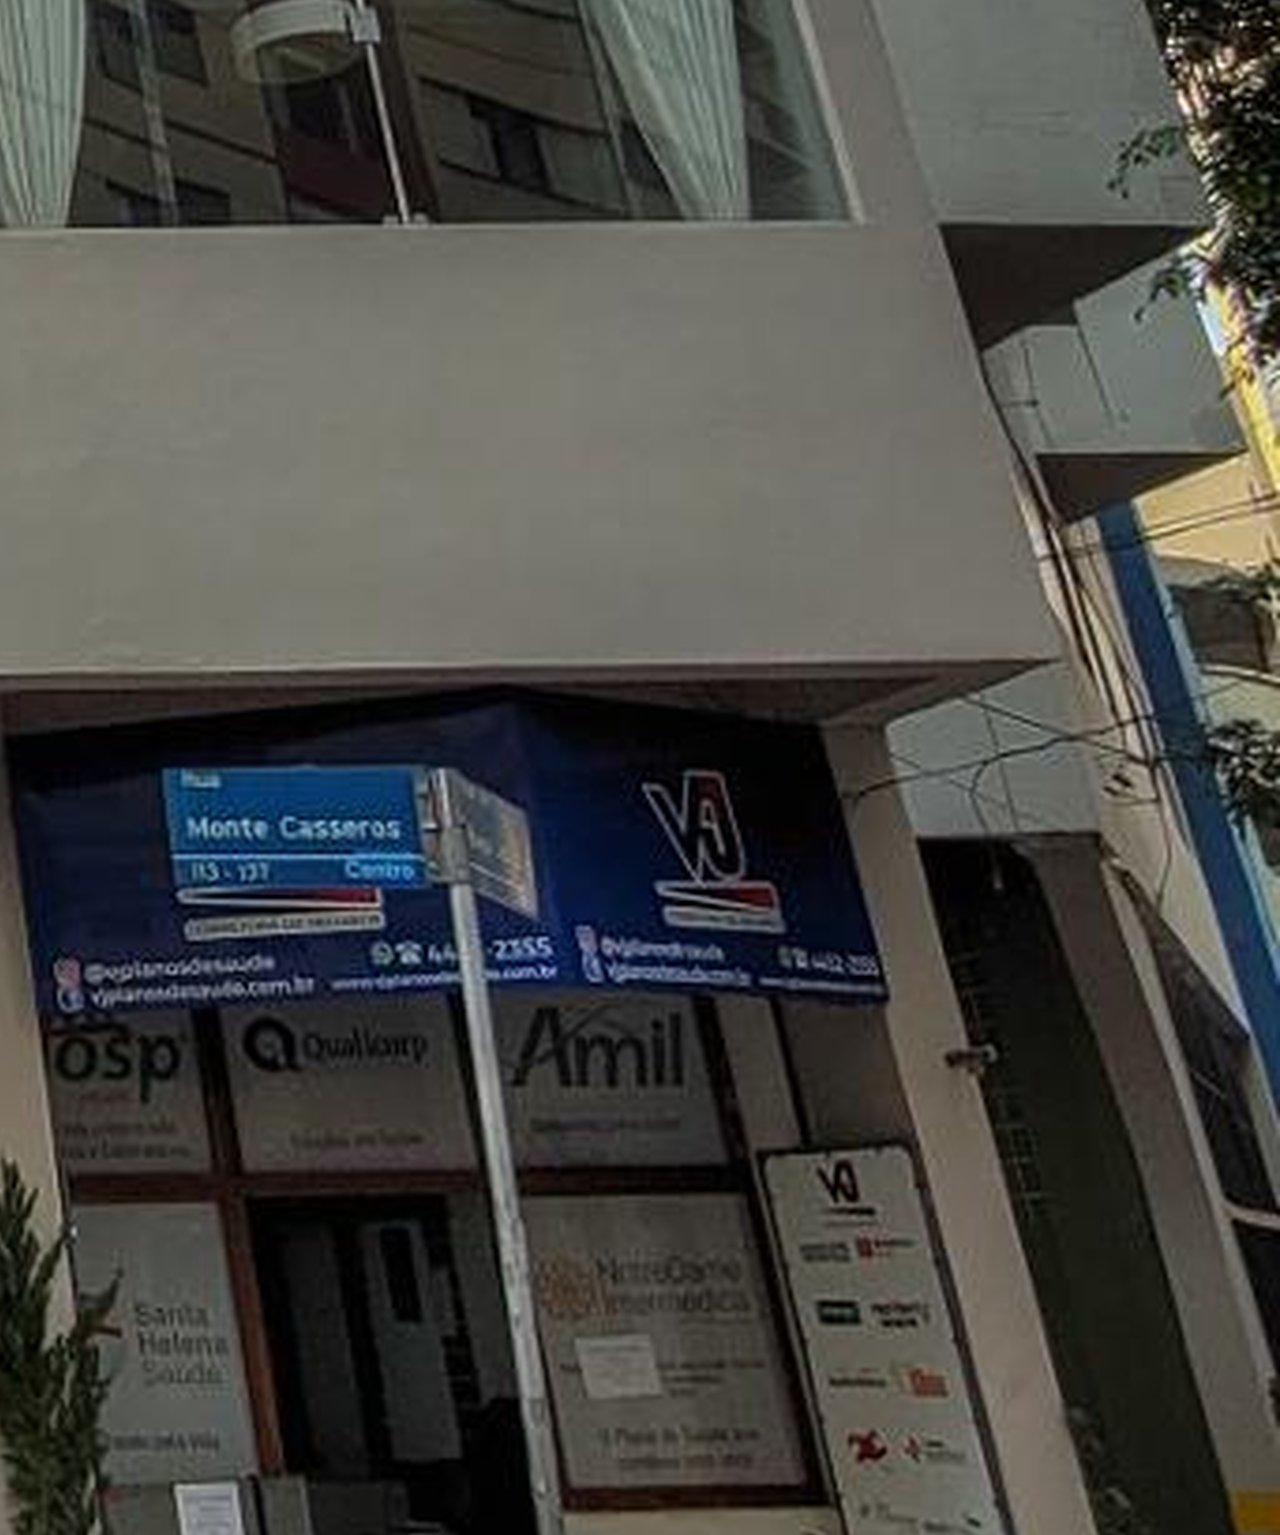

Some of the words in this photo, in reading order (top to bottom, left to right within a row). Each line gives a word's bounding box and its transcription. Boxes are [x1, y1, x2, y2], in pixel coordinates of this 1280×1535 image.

[186, 816, 269, 841] Monte
[279, 815, 401, 842] Casseros
[344, 859, 415, 880] Centro
[428, 935, 555, 965] 44-2355
[302, 1027, 430, 1068] Qualicorp
[512, 1006, 684, 1087] Amil
[134, 1304, 210, 1328] Santa
[137, 1330, 232, 1356] Helena
